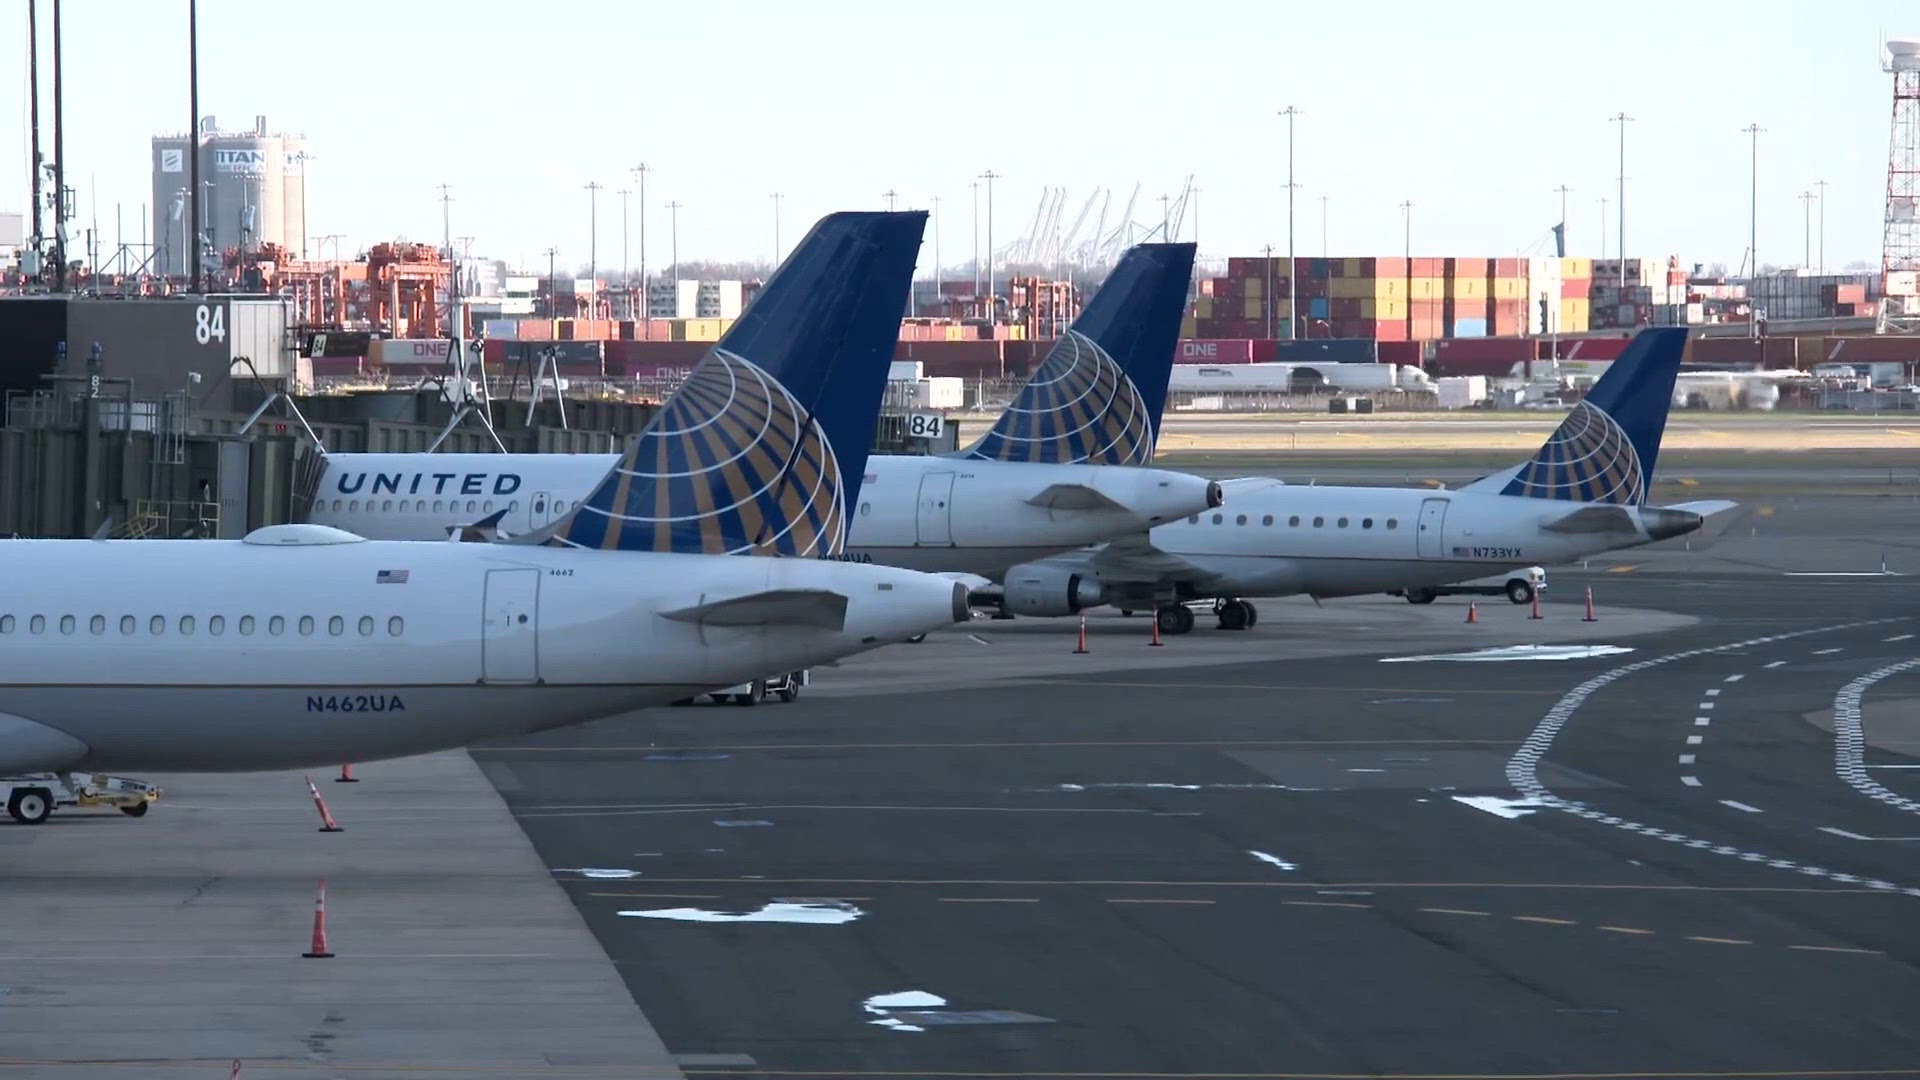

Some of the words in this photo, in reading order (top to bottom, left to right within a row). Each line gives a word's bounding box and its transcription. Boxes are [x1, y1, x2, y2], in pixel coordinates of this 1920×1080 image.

[196, 304, 225, 345] 84
[313, 339, 325, 353] 84
[413, 343, 447, 356] ONE
[1183, 342, 1217, 356] ONE
[911, 415, 940, 437] 84
[337, 472, 521, 495] UNITED
[1473, 547, 1521, 558] N733YX
[549, 568, 574, 576] 4662
[306, 695, 405, 712] N462UA
